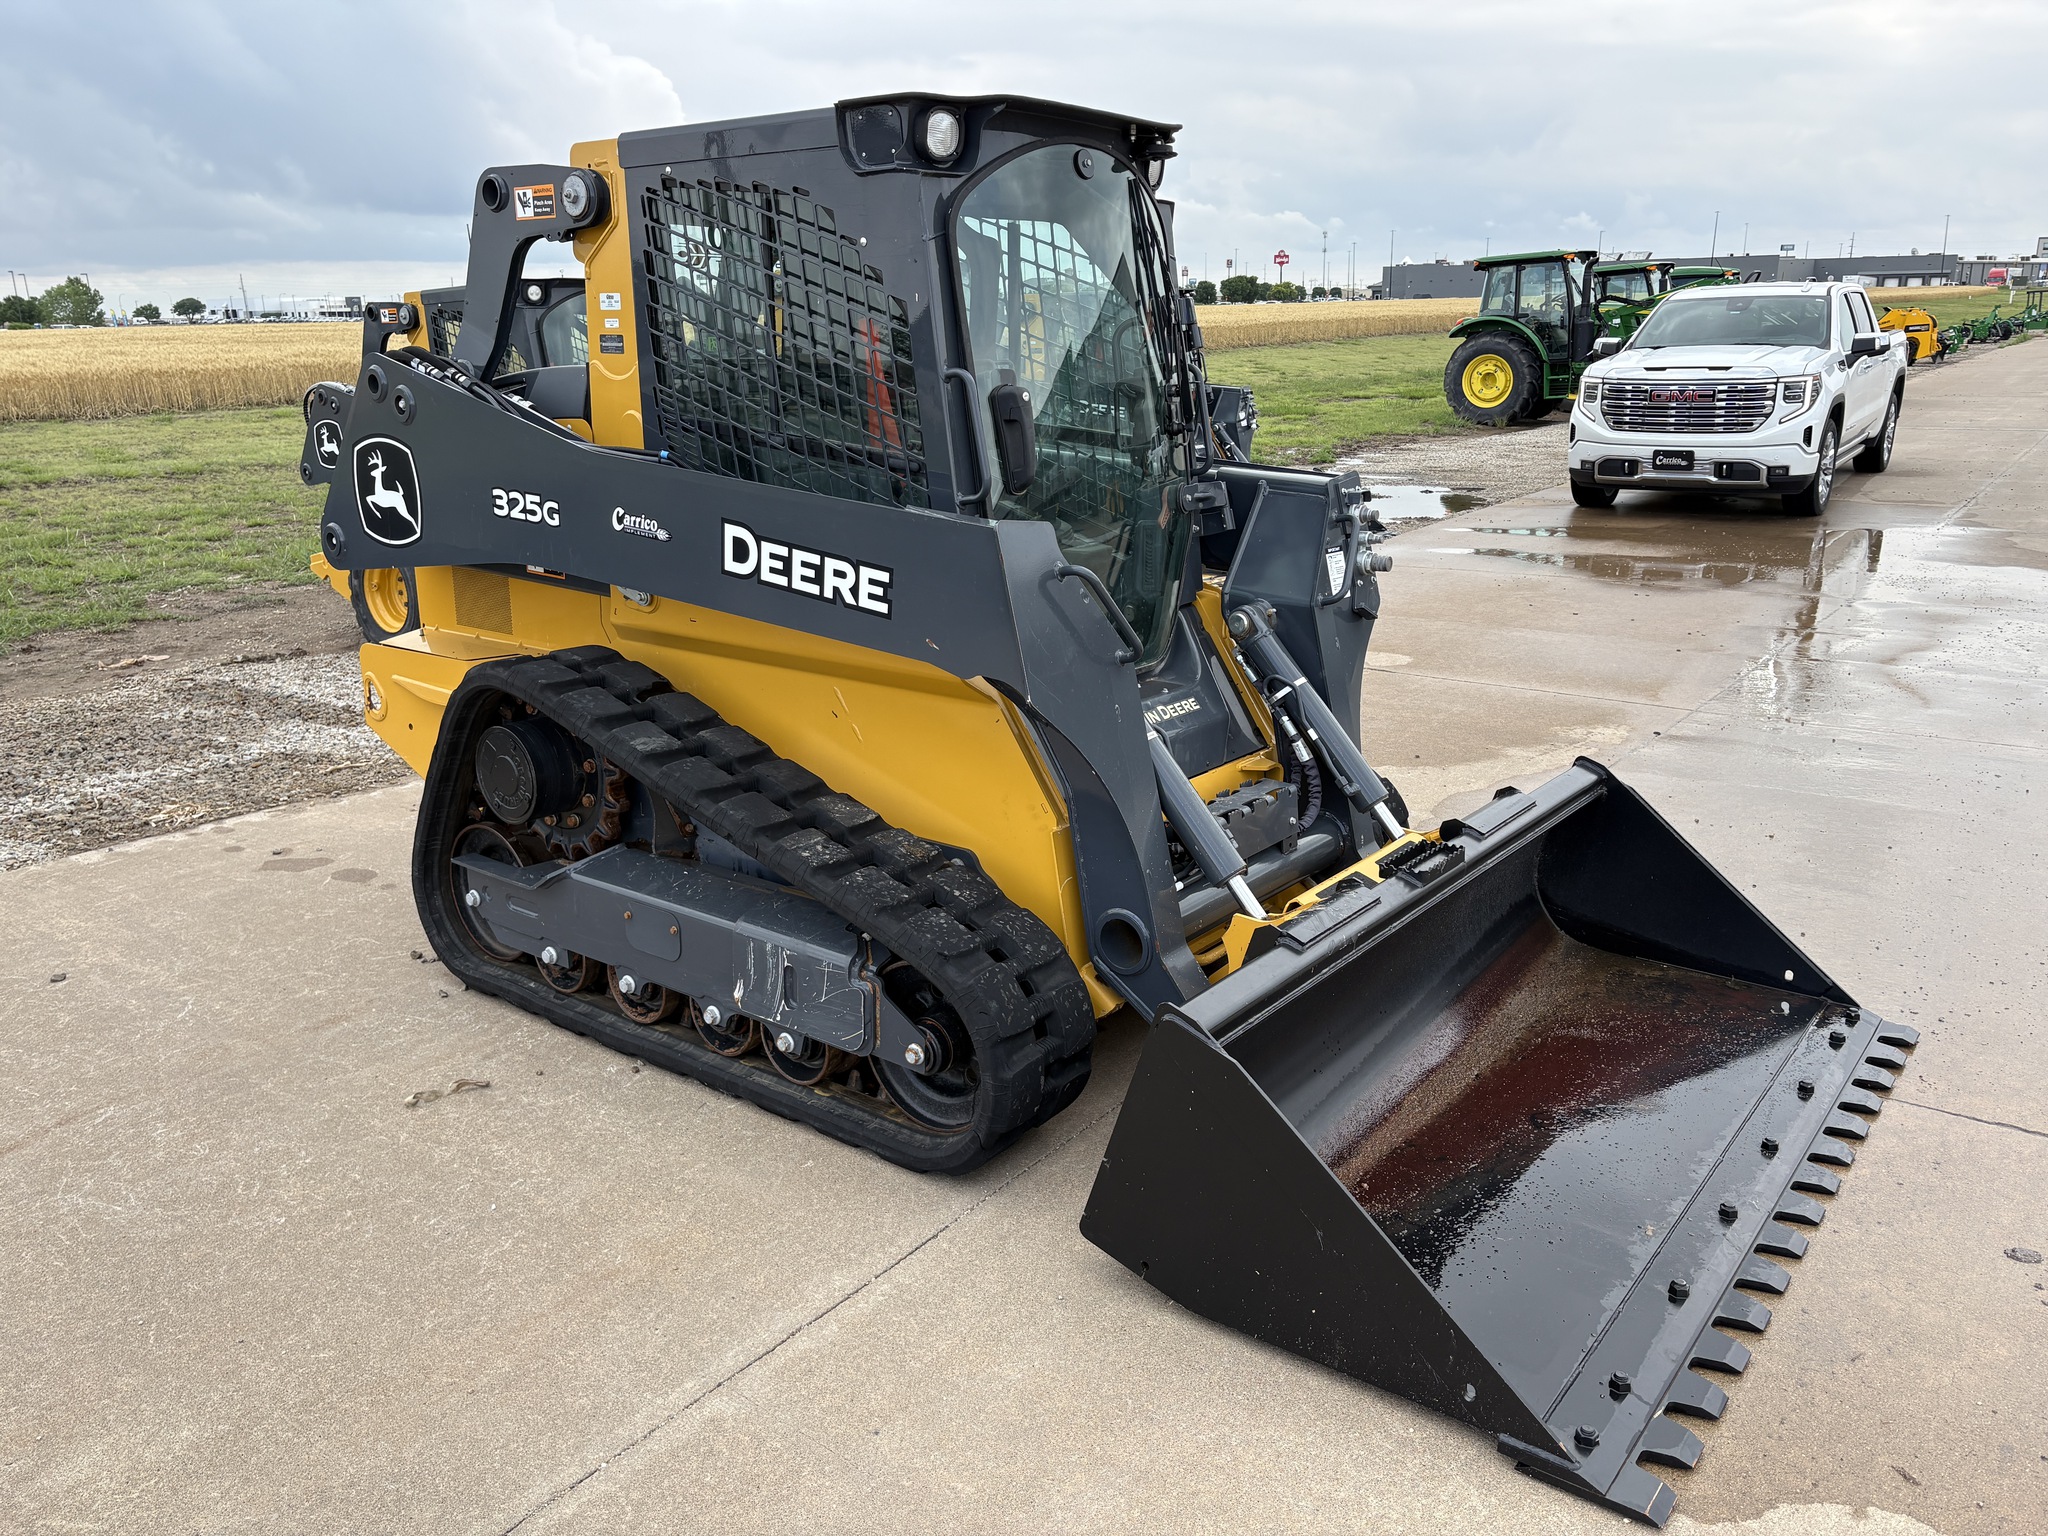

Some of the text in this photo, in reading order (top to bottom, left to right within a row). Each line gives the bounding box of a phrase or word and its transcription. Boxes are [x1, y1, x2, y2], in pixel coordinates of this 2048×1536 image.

[1651, 390, 1713, 402] GMC
[1655, 455, 1682, 465] Carrico
[492, 488, 560, 527] 325G
[612, 506, 658, 532] Carrico
[624, 528, 656, 539] IMPLEMENT
[723, 521, 891, 615] DEERE
[1156, 698, 1200, 720] DEERE
